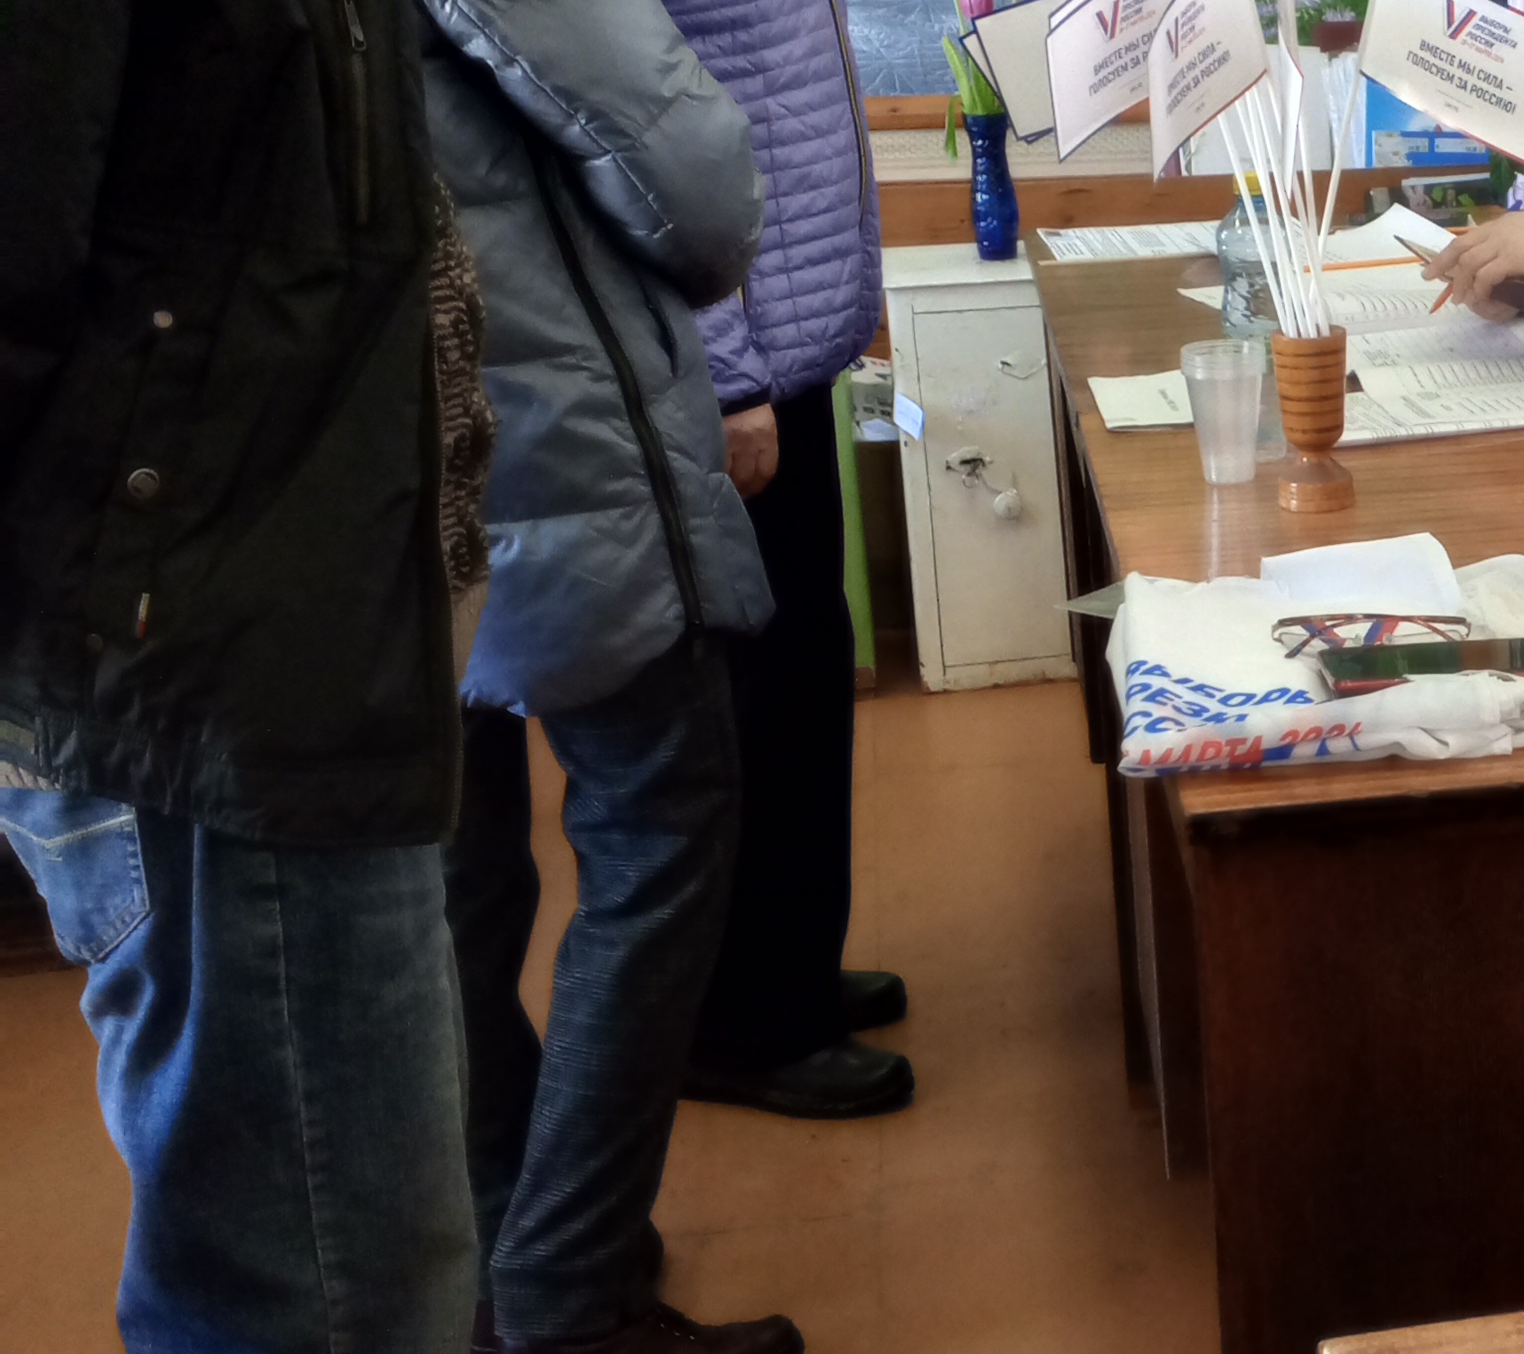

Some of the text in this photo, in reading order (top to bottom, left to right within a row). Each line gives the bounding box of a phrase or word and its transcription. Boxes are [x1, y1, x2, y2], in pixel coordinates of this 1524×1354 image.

[1406, 50, 1456, 84] ГОЛОСУЕМ
[1455, 76, 1468, 92] ЗА
[1469, 83, 1517, 115] РОССИЮ!
[1418, 39, 1457, 67] ВМЕСТЕ
[1456, 58, 1476, 77] МЫ
[1476, 68, 1504, 91] СИЛА
